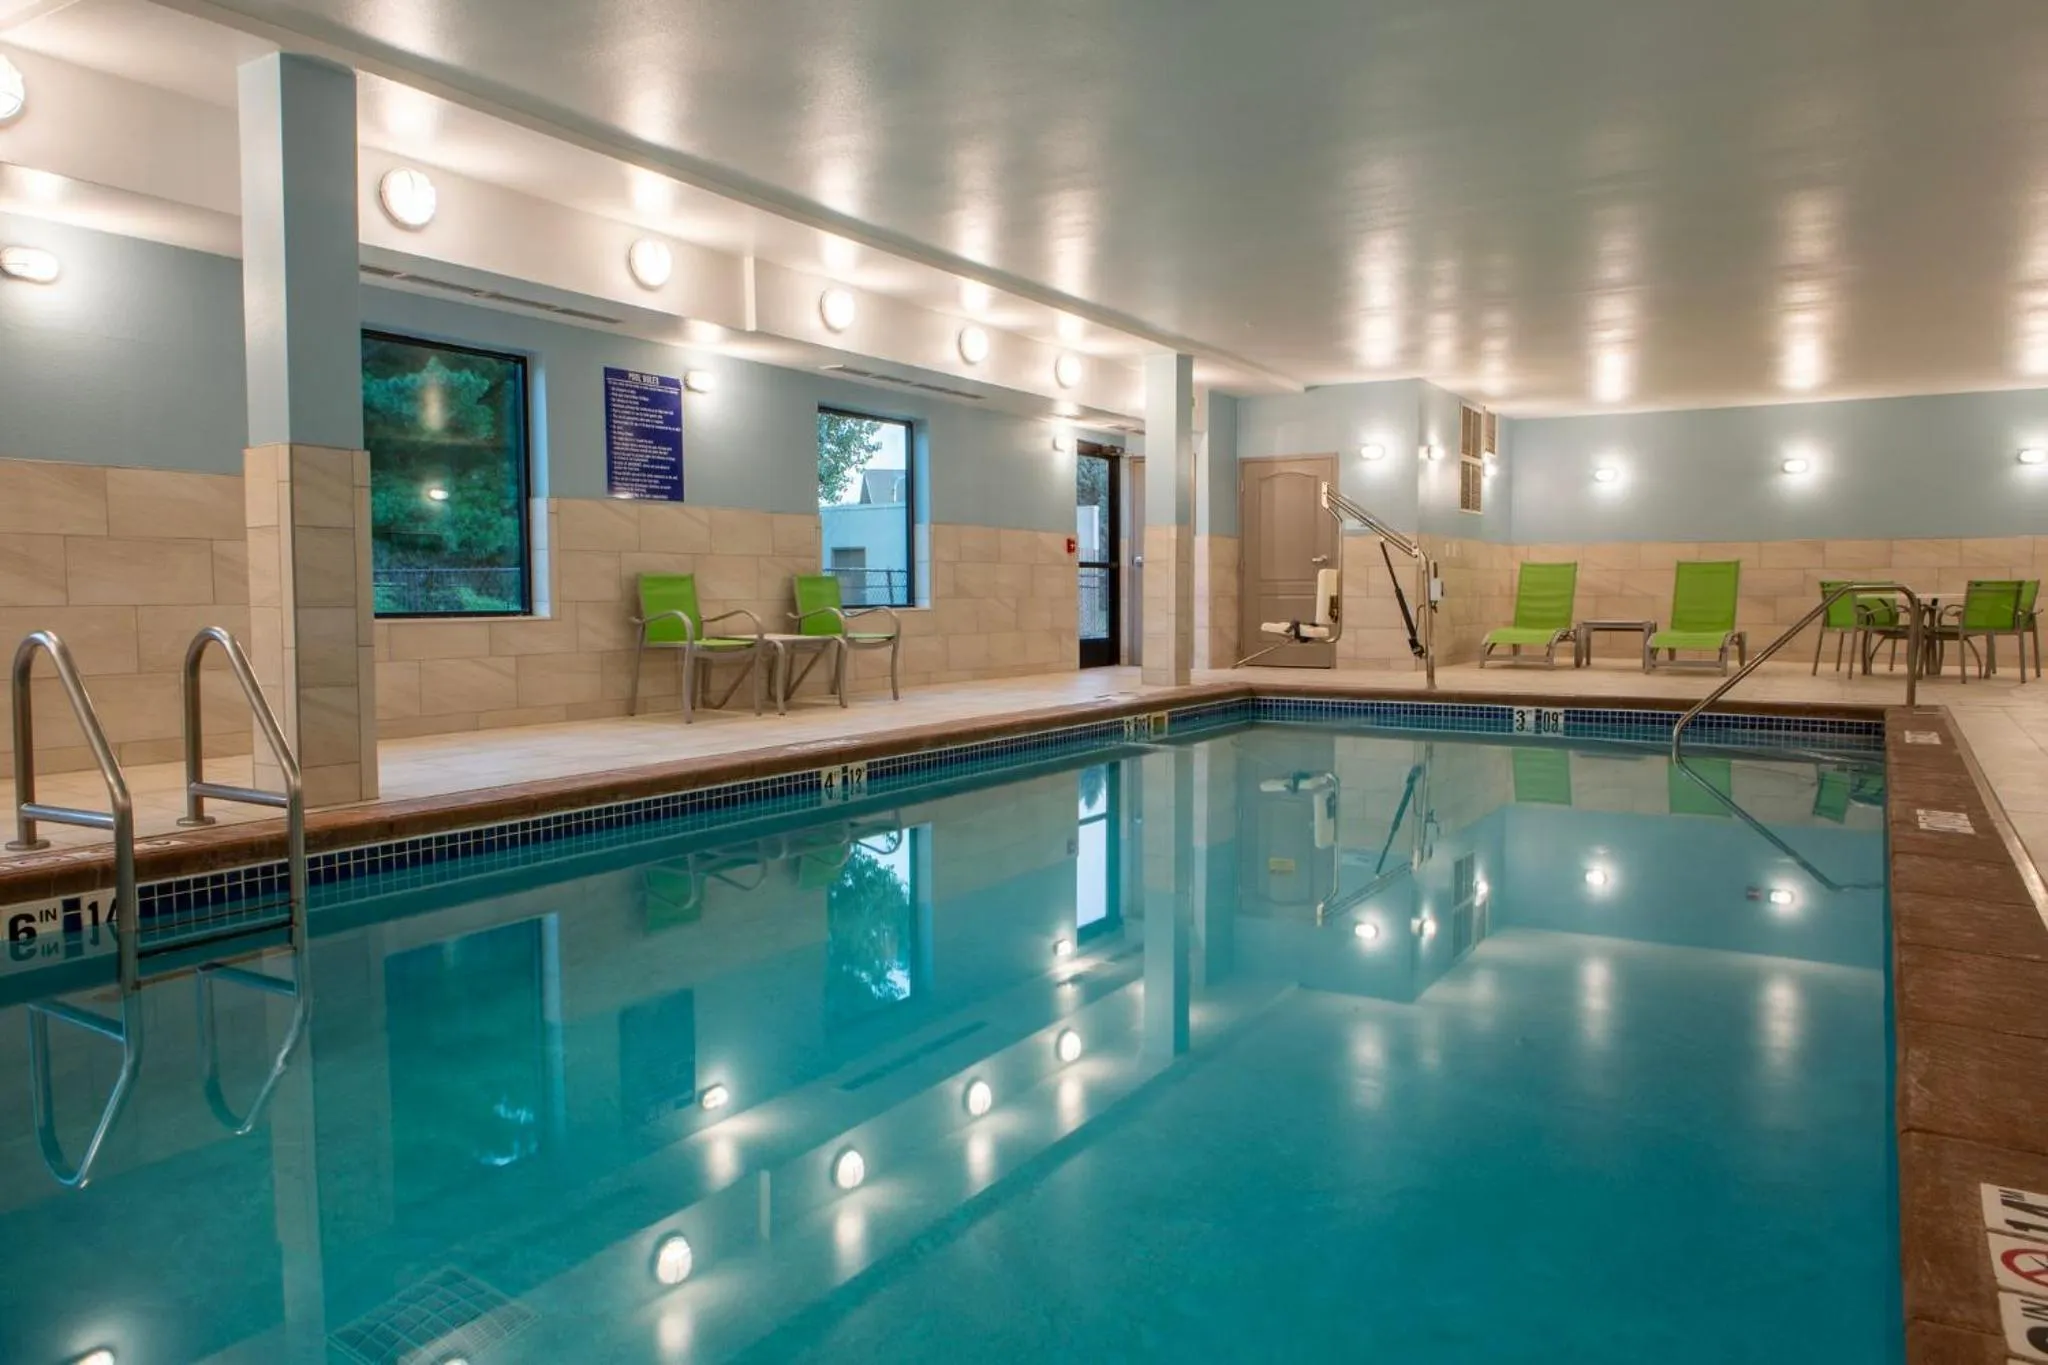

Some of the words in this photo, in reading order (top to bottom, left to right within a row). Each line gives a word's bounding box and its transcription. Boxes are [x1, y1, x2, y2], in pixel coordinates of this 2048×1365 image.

[824, 772, 834, 787] 4
[8, 913, 37, 943] 6
[39, 907, 58, 923] IN
